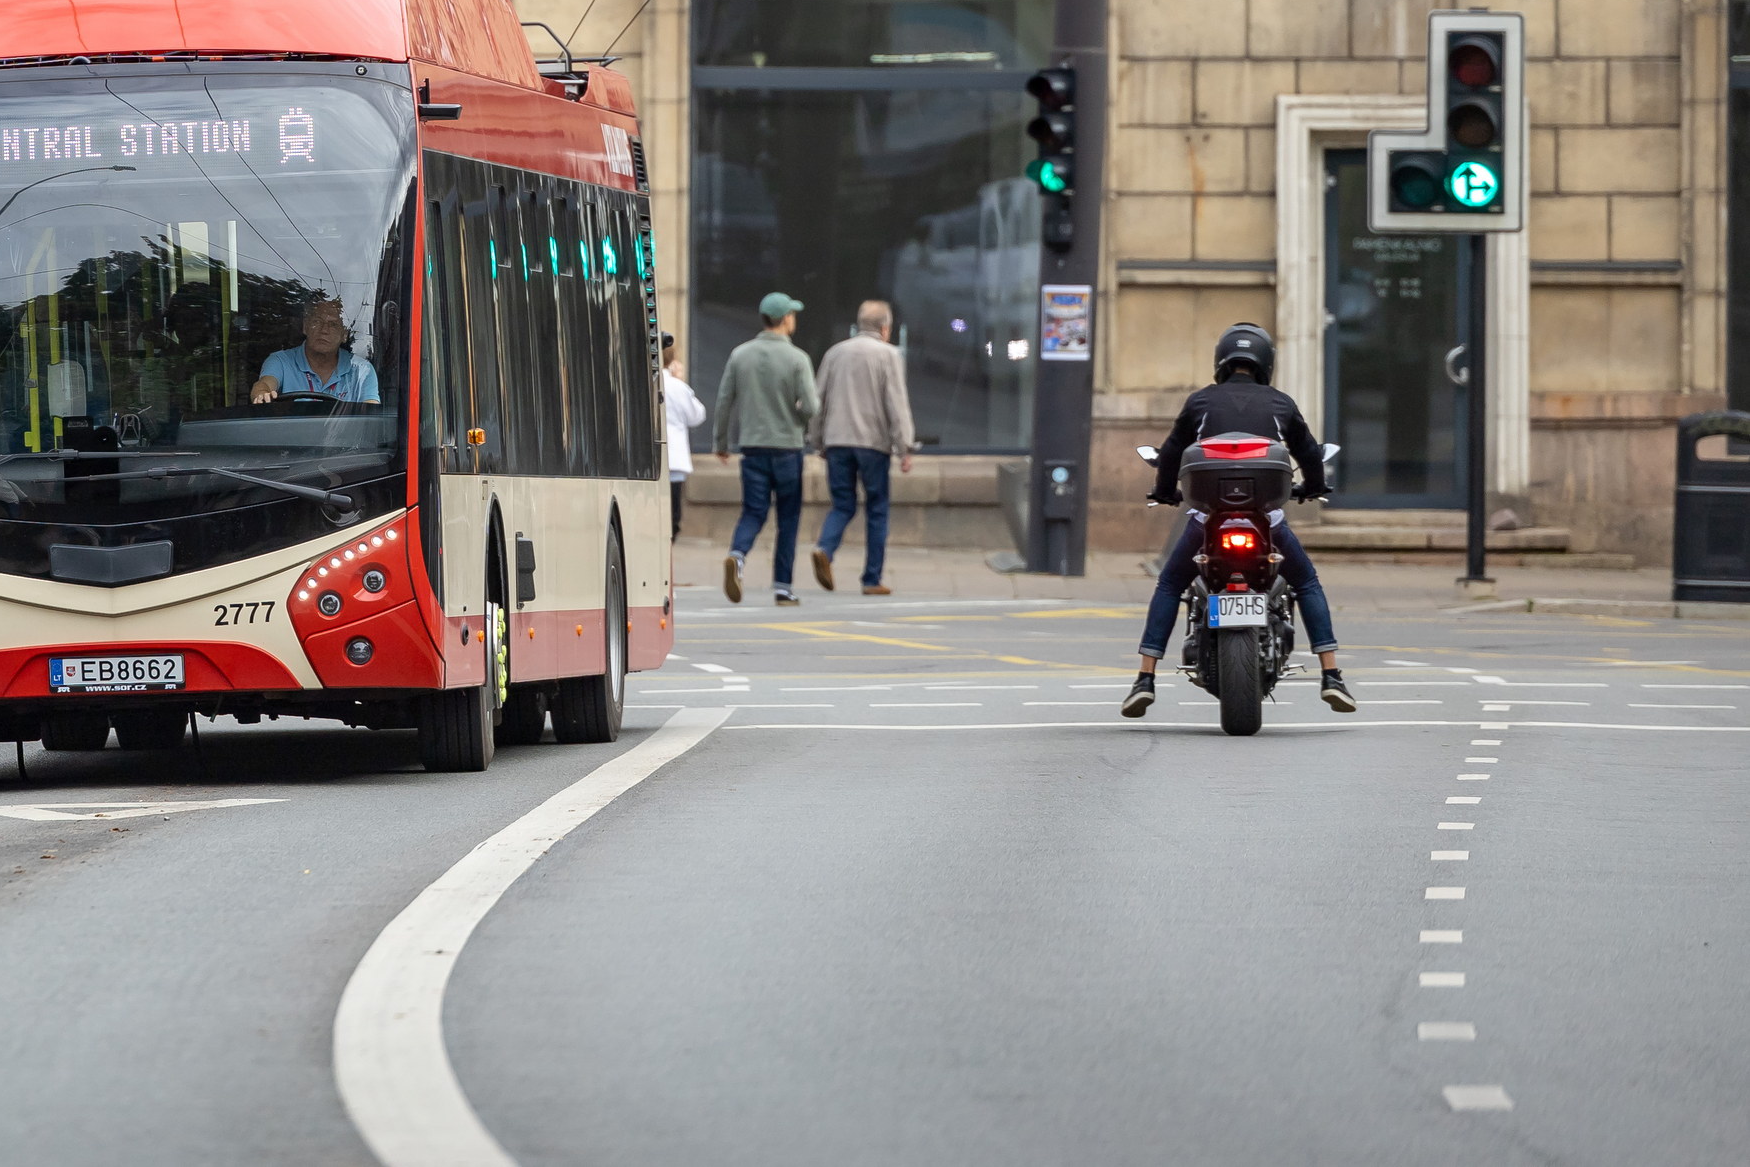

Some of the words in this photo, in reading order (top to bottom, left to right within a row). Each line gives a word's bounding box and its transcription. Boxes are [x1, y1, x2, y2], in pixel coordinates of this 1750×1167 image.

[120, 120, 251, 157] STATION
[214, 601, 276, 627] 2777
[1219, 596, 1265, 616] 075HS
[80, 659, 177, 682] EB8662
[85, 684, 147, 692] www.sor.cz
